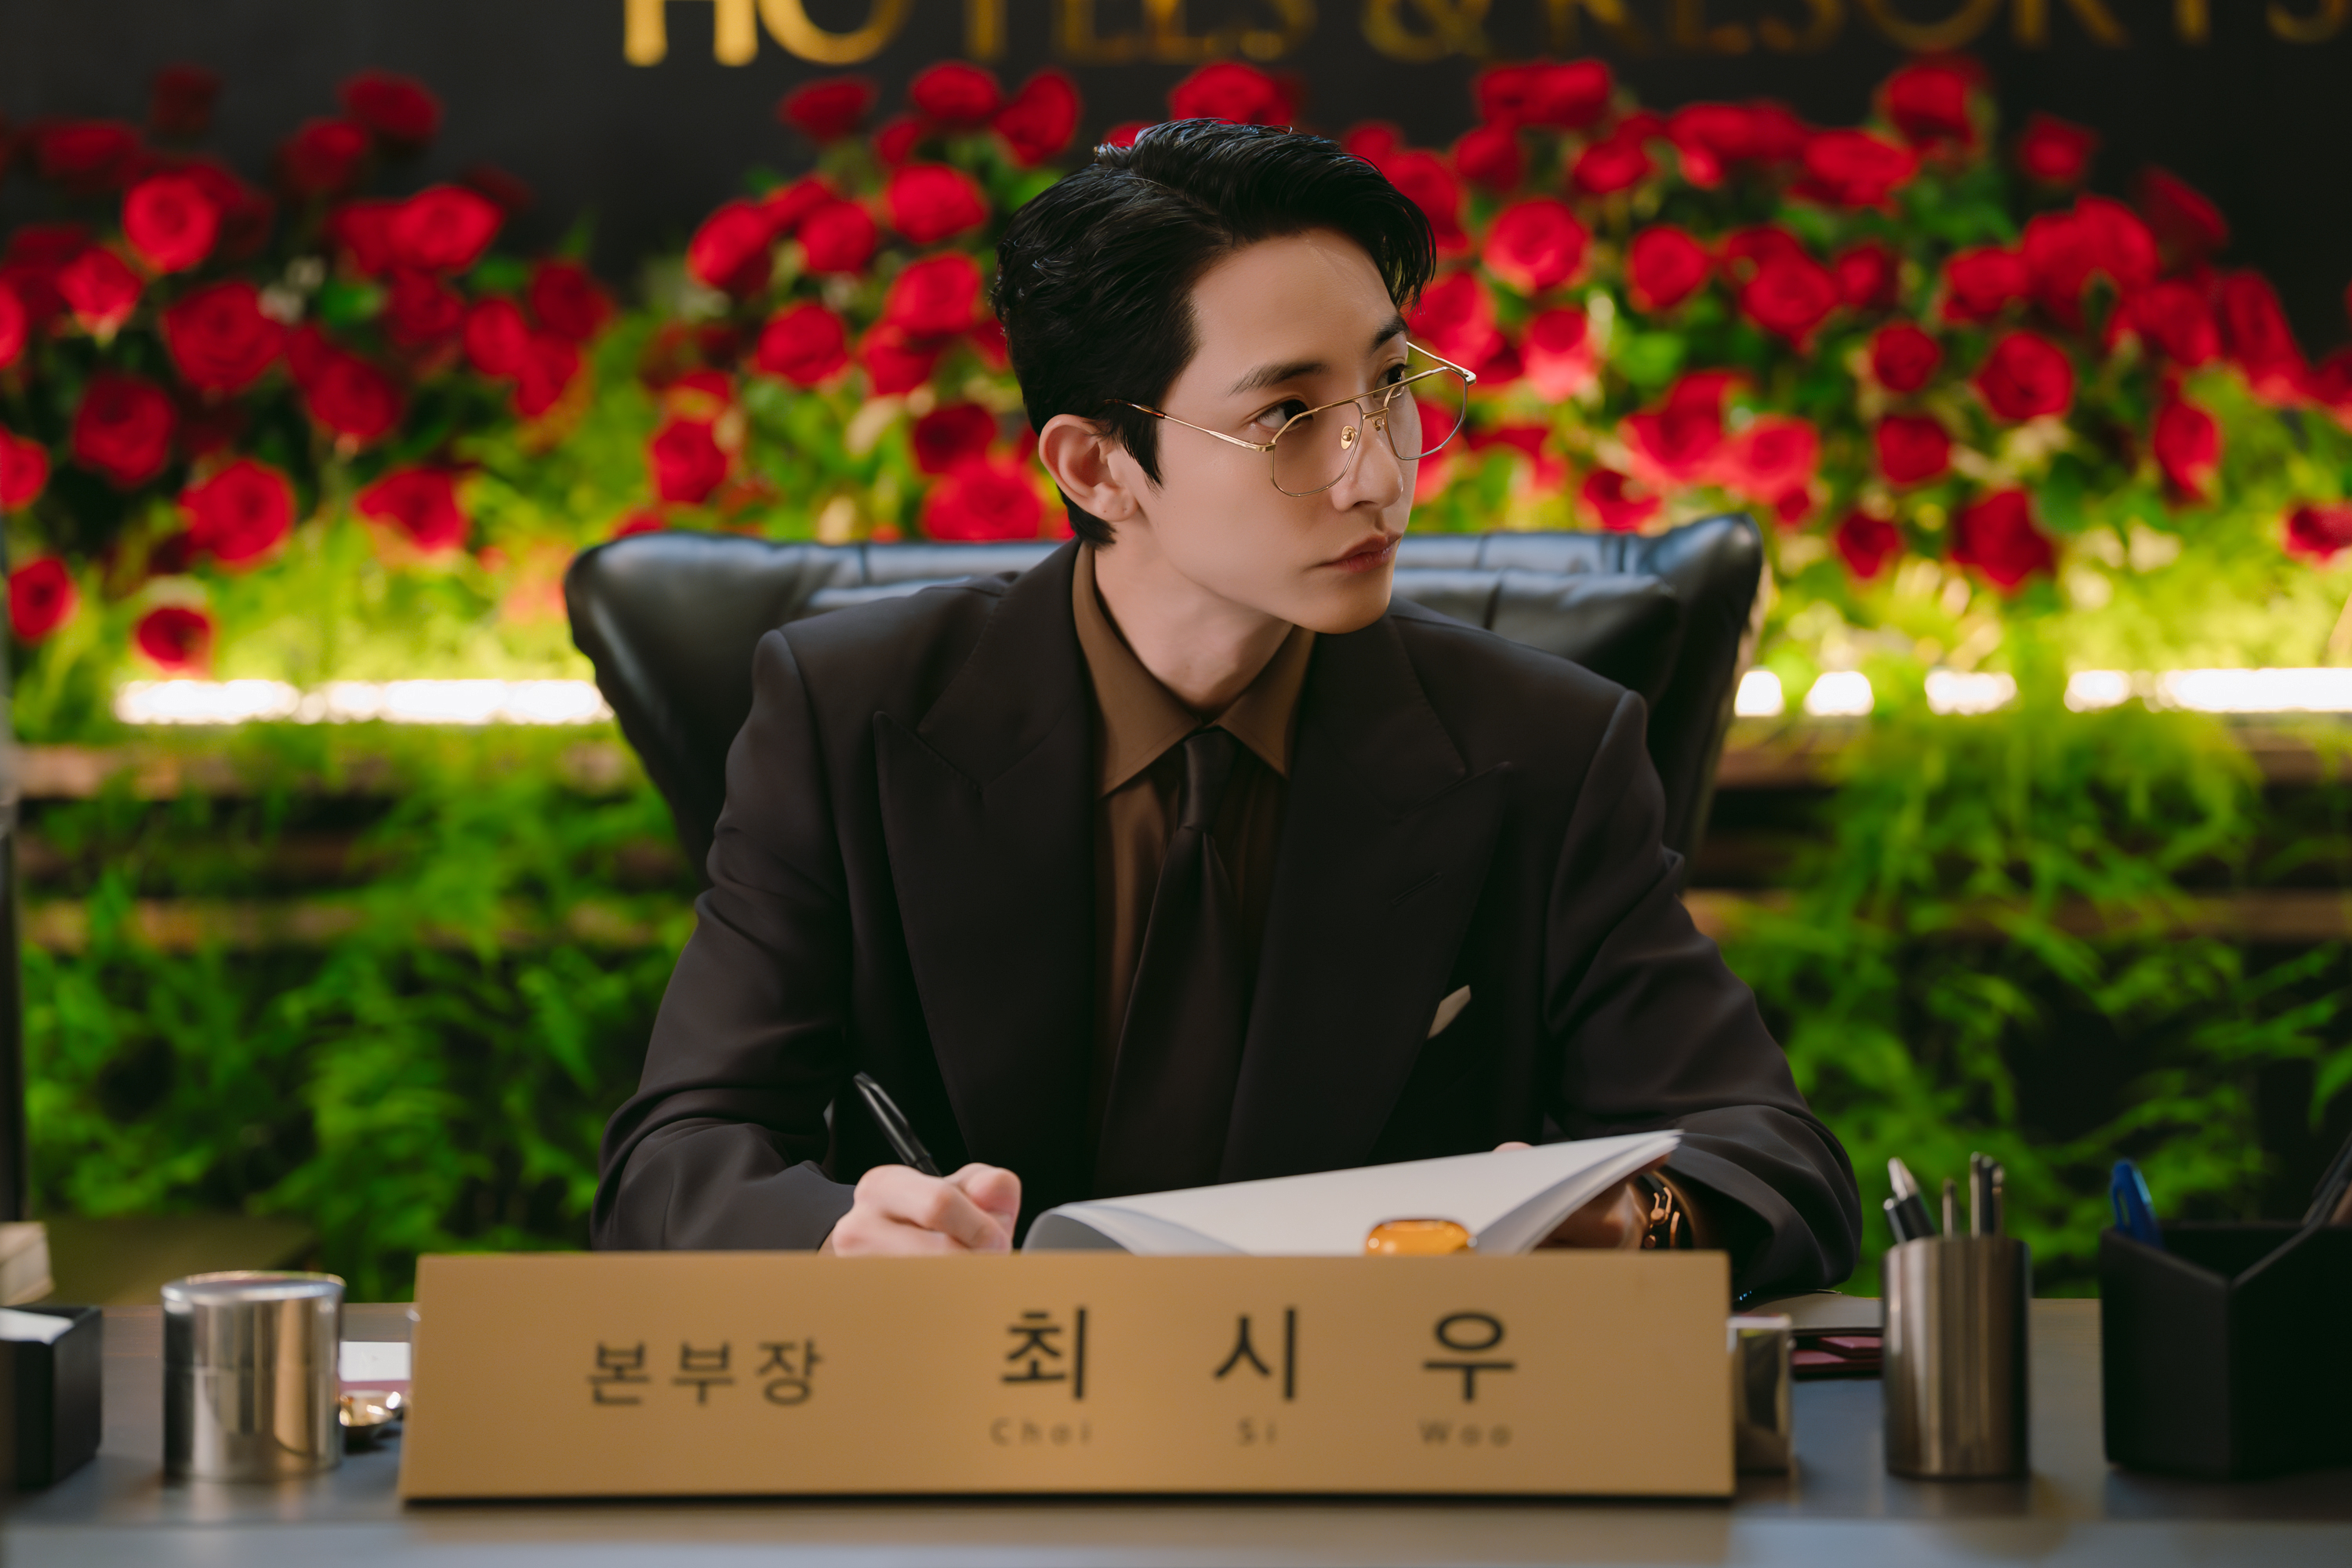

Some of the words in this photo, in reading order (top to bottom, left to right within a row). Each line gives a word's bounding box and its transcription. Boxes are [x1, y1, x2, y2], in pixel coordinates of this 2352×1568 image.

[587, 1339, 822, 1407] 본부장
[1000, 1305, 1089, 1402] 최
[1213, 1305, 1298, 1403] 시
[1421, 1308, 1517, 1403] 우
[989, 1417, 1091, 1446] Choi
[1237, 1417, 1276, 1446] Si
[1417, 1418, 1513, 1447] Woo
